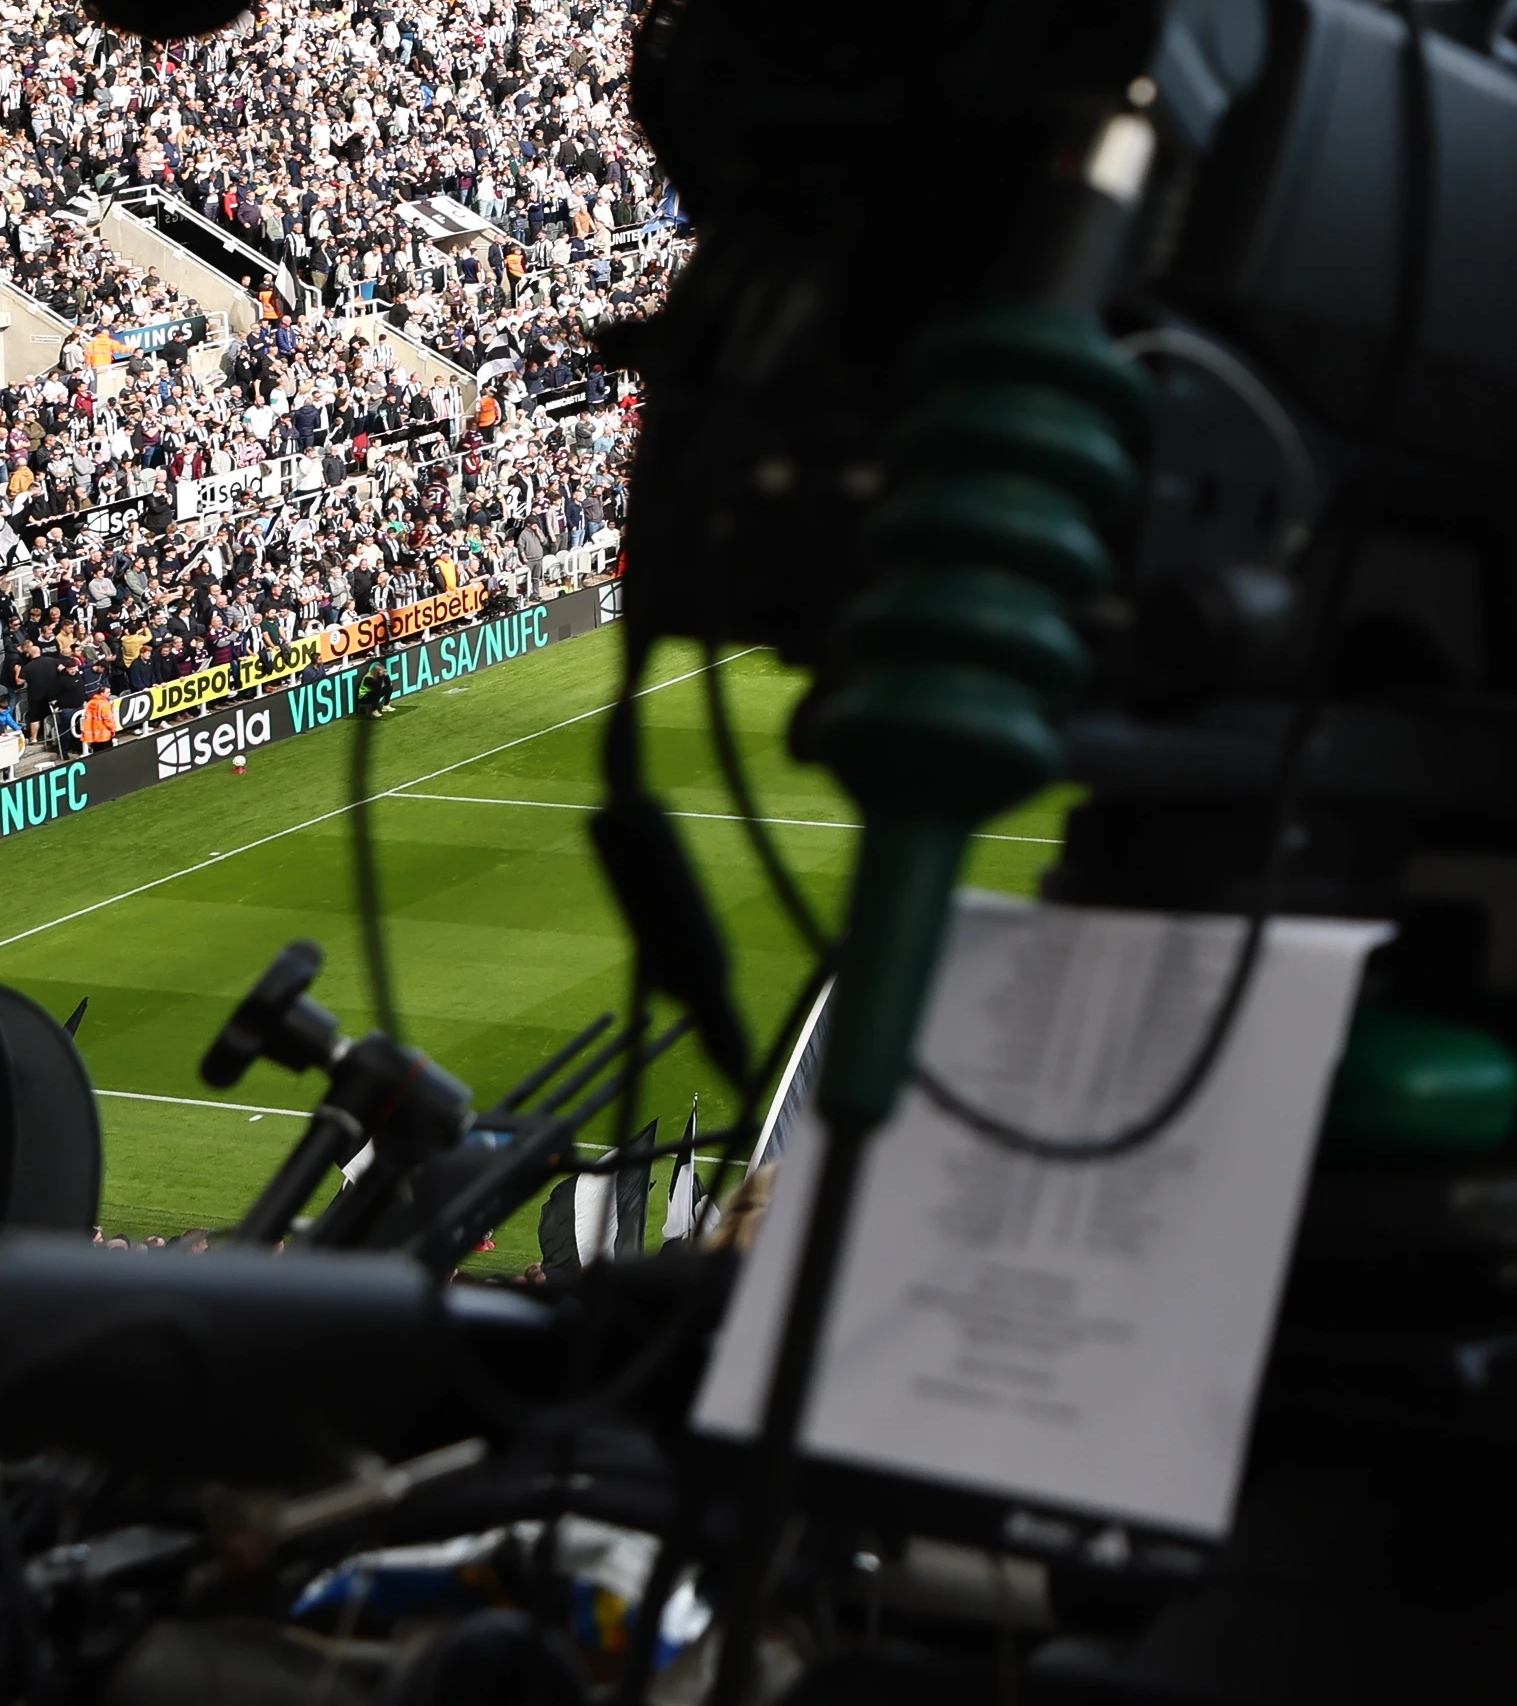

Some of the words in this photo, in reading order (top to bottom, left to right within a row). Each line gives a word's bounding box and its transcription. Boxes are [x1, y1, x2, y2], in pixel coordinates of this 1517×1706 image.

[219, 473, 263, 504] sela
[122, 694, 150, 725] JD
[288, 668, 358, 734] VISIT
[193, 708, 272, 766] sela
[0, 761, 88, 836] NUFC
